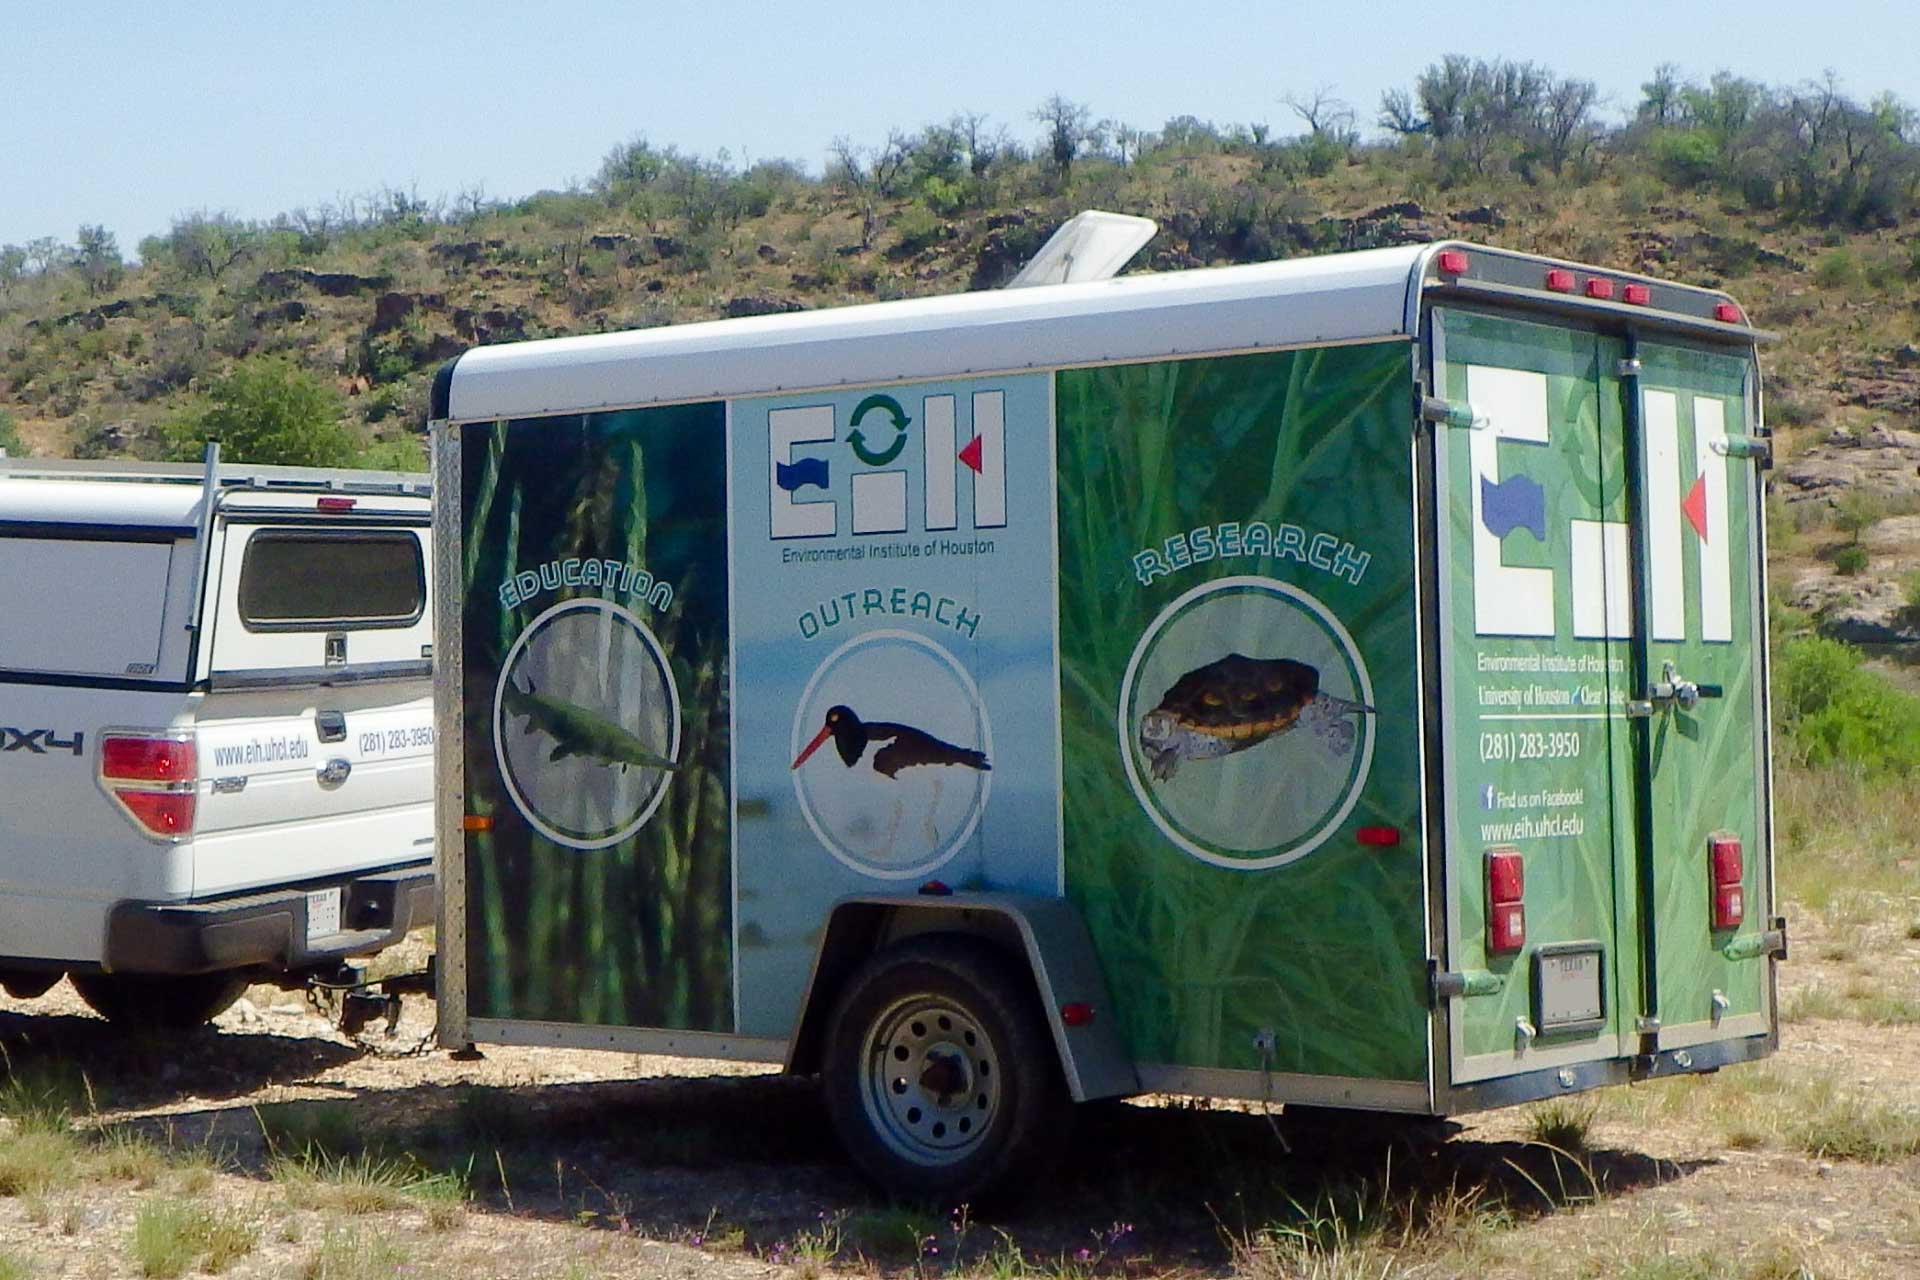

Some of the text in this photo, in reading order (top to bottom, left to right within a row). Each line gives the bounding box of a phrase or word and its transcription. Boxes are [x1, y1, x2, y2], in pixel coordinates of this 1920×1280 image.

[782, 539, 995, 564] Environmental Institute of Houston
[1133, 521, 1372, 586] RESEARCH
[499, 557, 674, 613] EDUCATION
[798, 587, 981, 639] OUTREACH
[1477, 652, 1540, 673] Environmental
[1542, 652, 1576, 673] Institute
[1577, 652, 1587, 673] of
[1523, 683, 1534, 705] of
[0, 727, 84, 756] X4
[214, 735, 308, 767] www.eih.uhcl.edu
[359, 726, 434, 758] (281) 283-3950
[1479, 731, 1580, 763] (281) 283-3950
[1497, 790, 1516, 809] Find
[1517, 795, 1528, 808] us
[1529, 794, 1541, 807] on
[1481, 812, 1584, 841] www.eih.uhcl.edu
